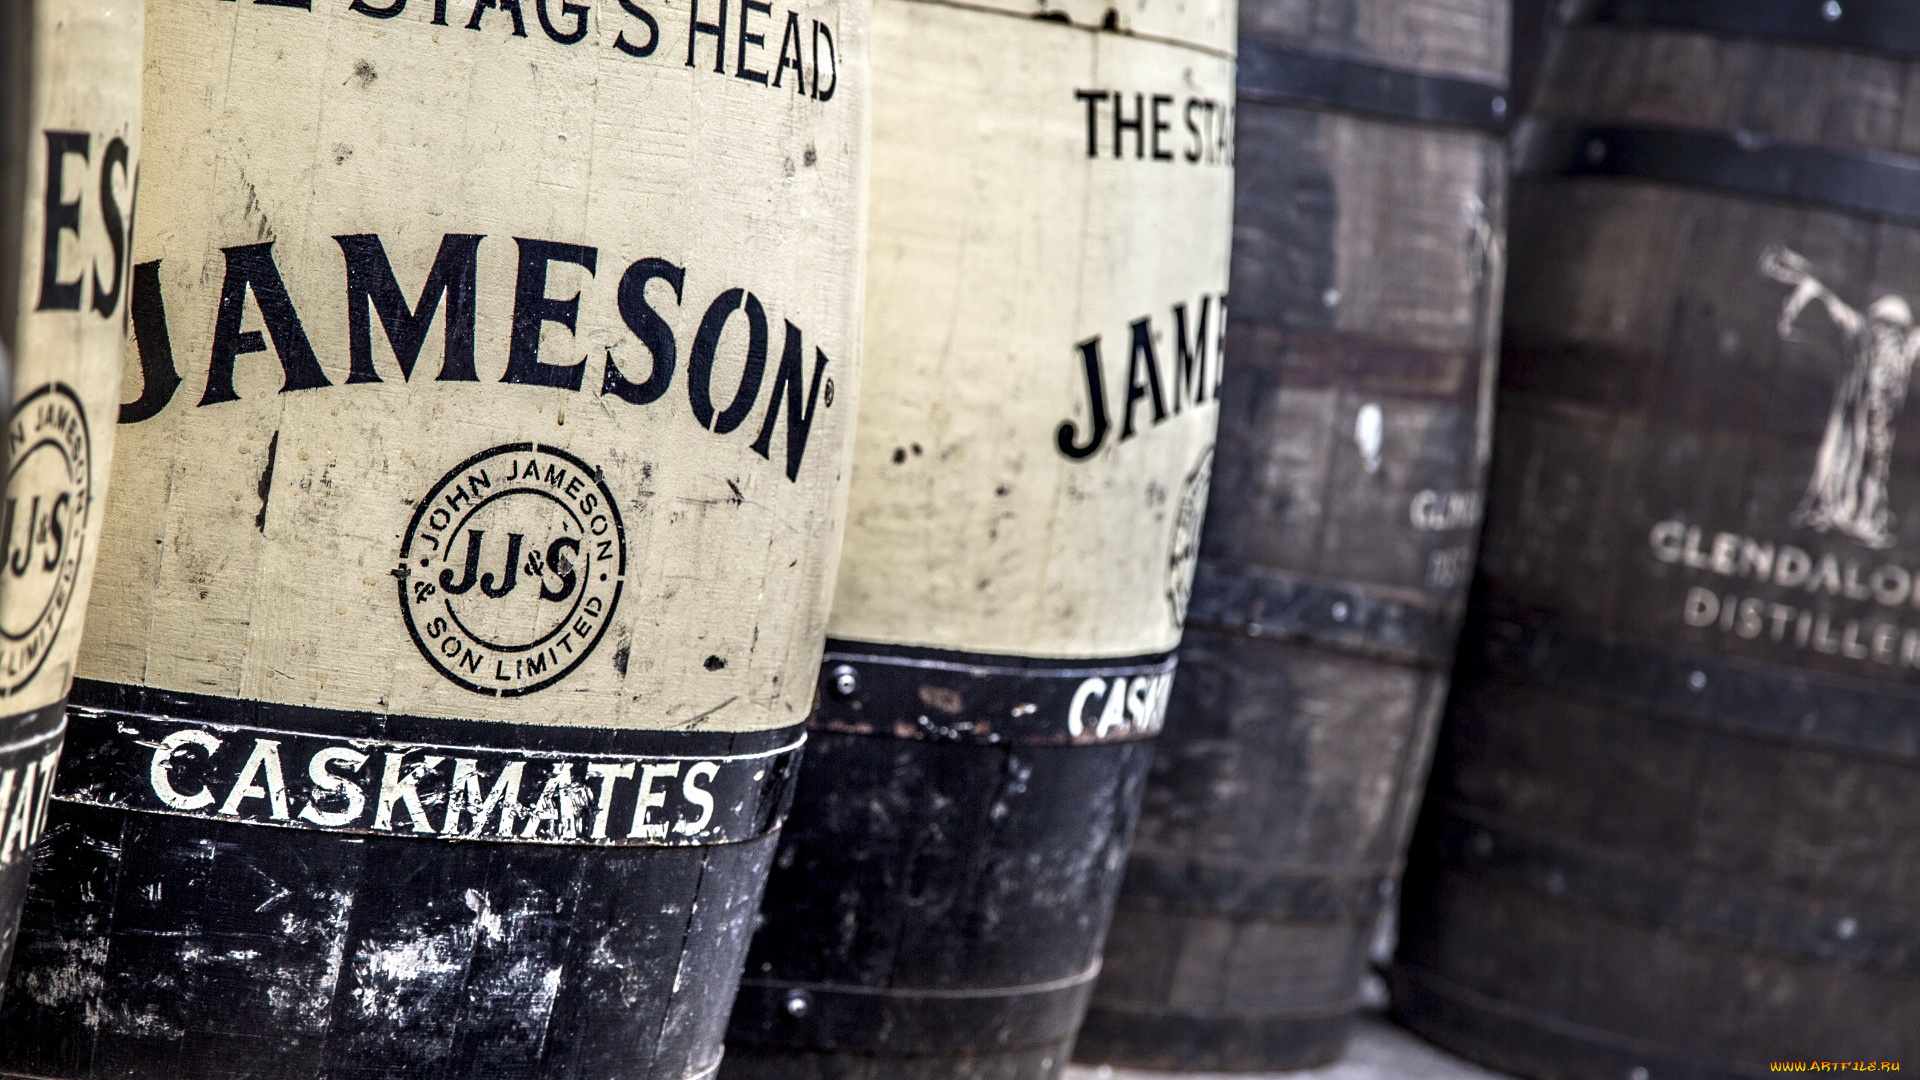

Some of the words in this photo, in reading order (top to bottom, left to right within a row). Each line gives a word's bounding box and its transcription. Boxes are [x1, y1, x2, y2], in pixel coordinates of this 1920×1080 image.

[684, 0, 837, 102] HEAD
[1074, 89, 1173, 160] THE
[34, 129, 139, 338] ES
[421, 469, 491, 551] JOHN
[507, 459, 613, 562] JAMESON
[438, 529, 581, 603] JJ&S
[1649, 519, 1920, 609] GLENDALO
[427, 617, 484, 673] SON
[495, 596, 603, 681] LIMITED
[150, 729, 721, 840] CASKMATES
